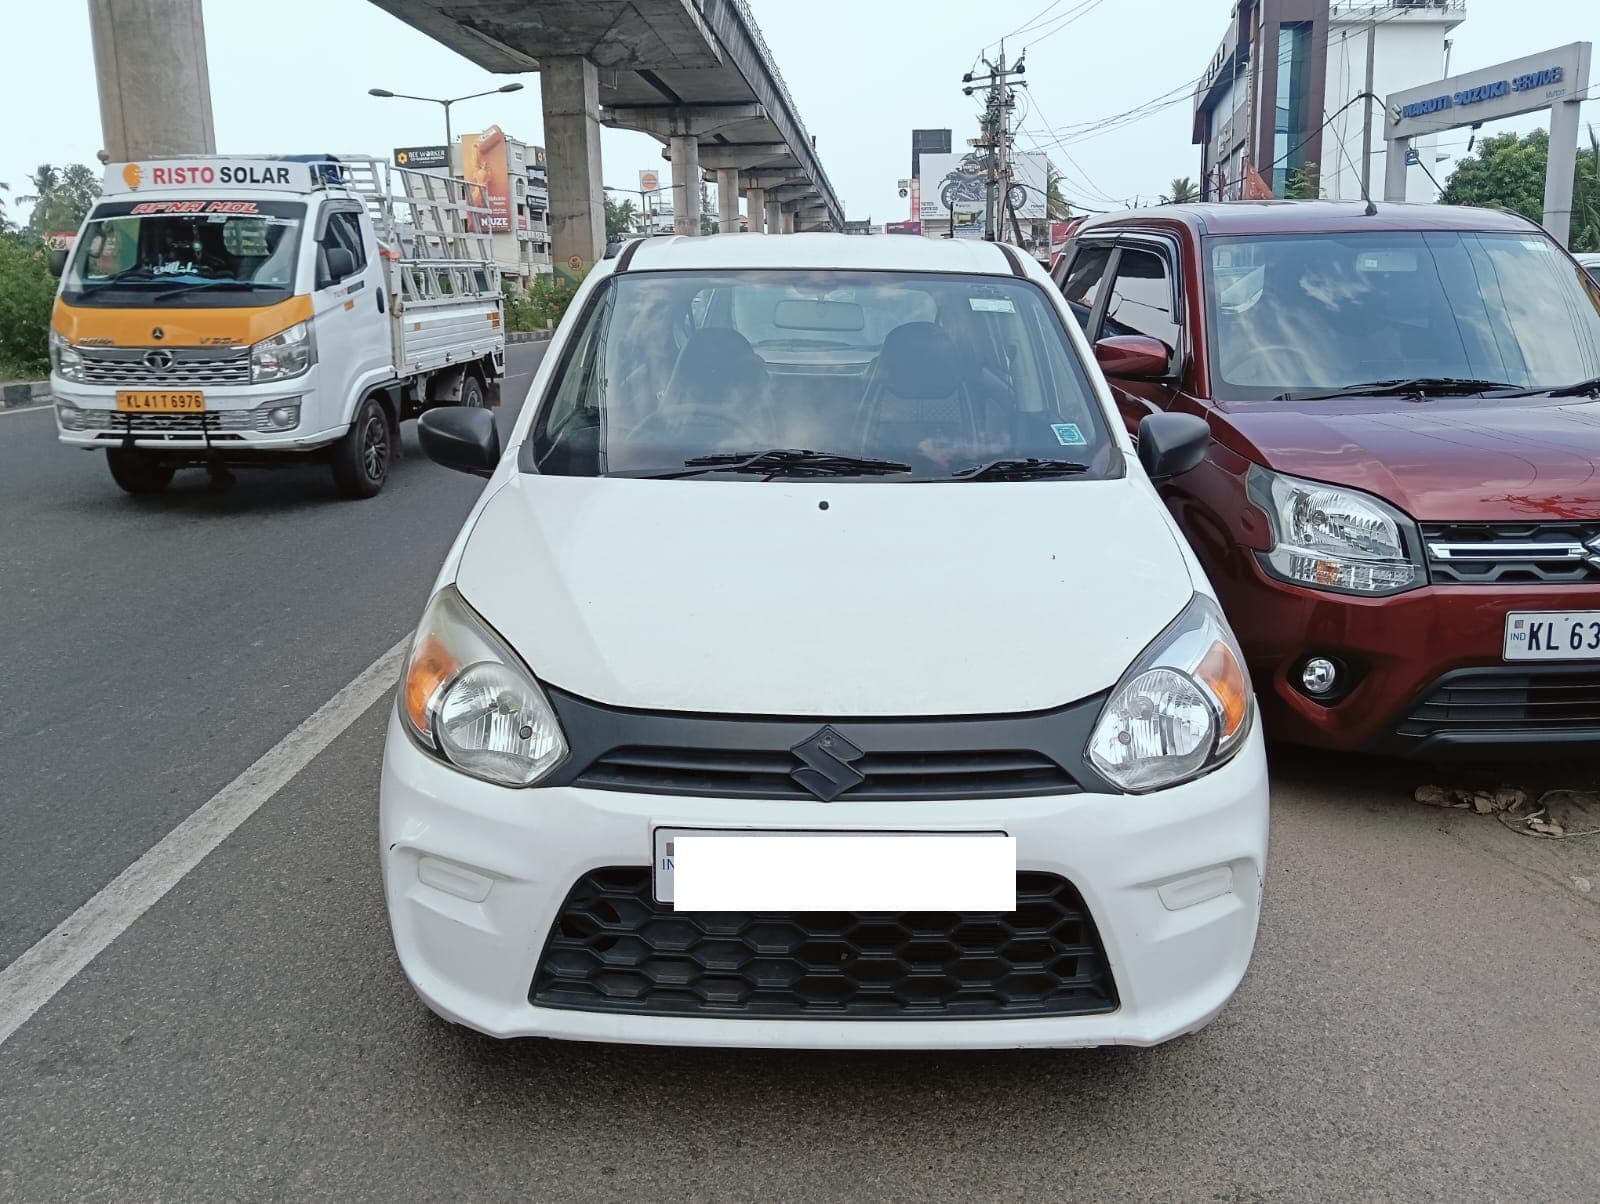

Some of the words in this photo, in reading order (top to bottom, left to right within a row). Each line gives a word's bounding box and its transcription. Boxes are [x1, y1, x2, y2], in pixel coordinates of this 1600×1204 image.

[1402, 95, 1453, 118] MARUTI
[1453, 80, 1509, 106] SUZUKI
[1511, 66, 1563, 92] SERVICE
[153, 166, 215, 185] RISTO
[220, 166, 290, 184] SOLAR
[171, 395, 202, 408] 6976
[1510, 632, 1526, 641] IND
[1527, 622, 1560, 651] KL
[1569, 621, 1600, 650] 63
[662, 858, 674, 871] IN
